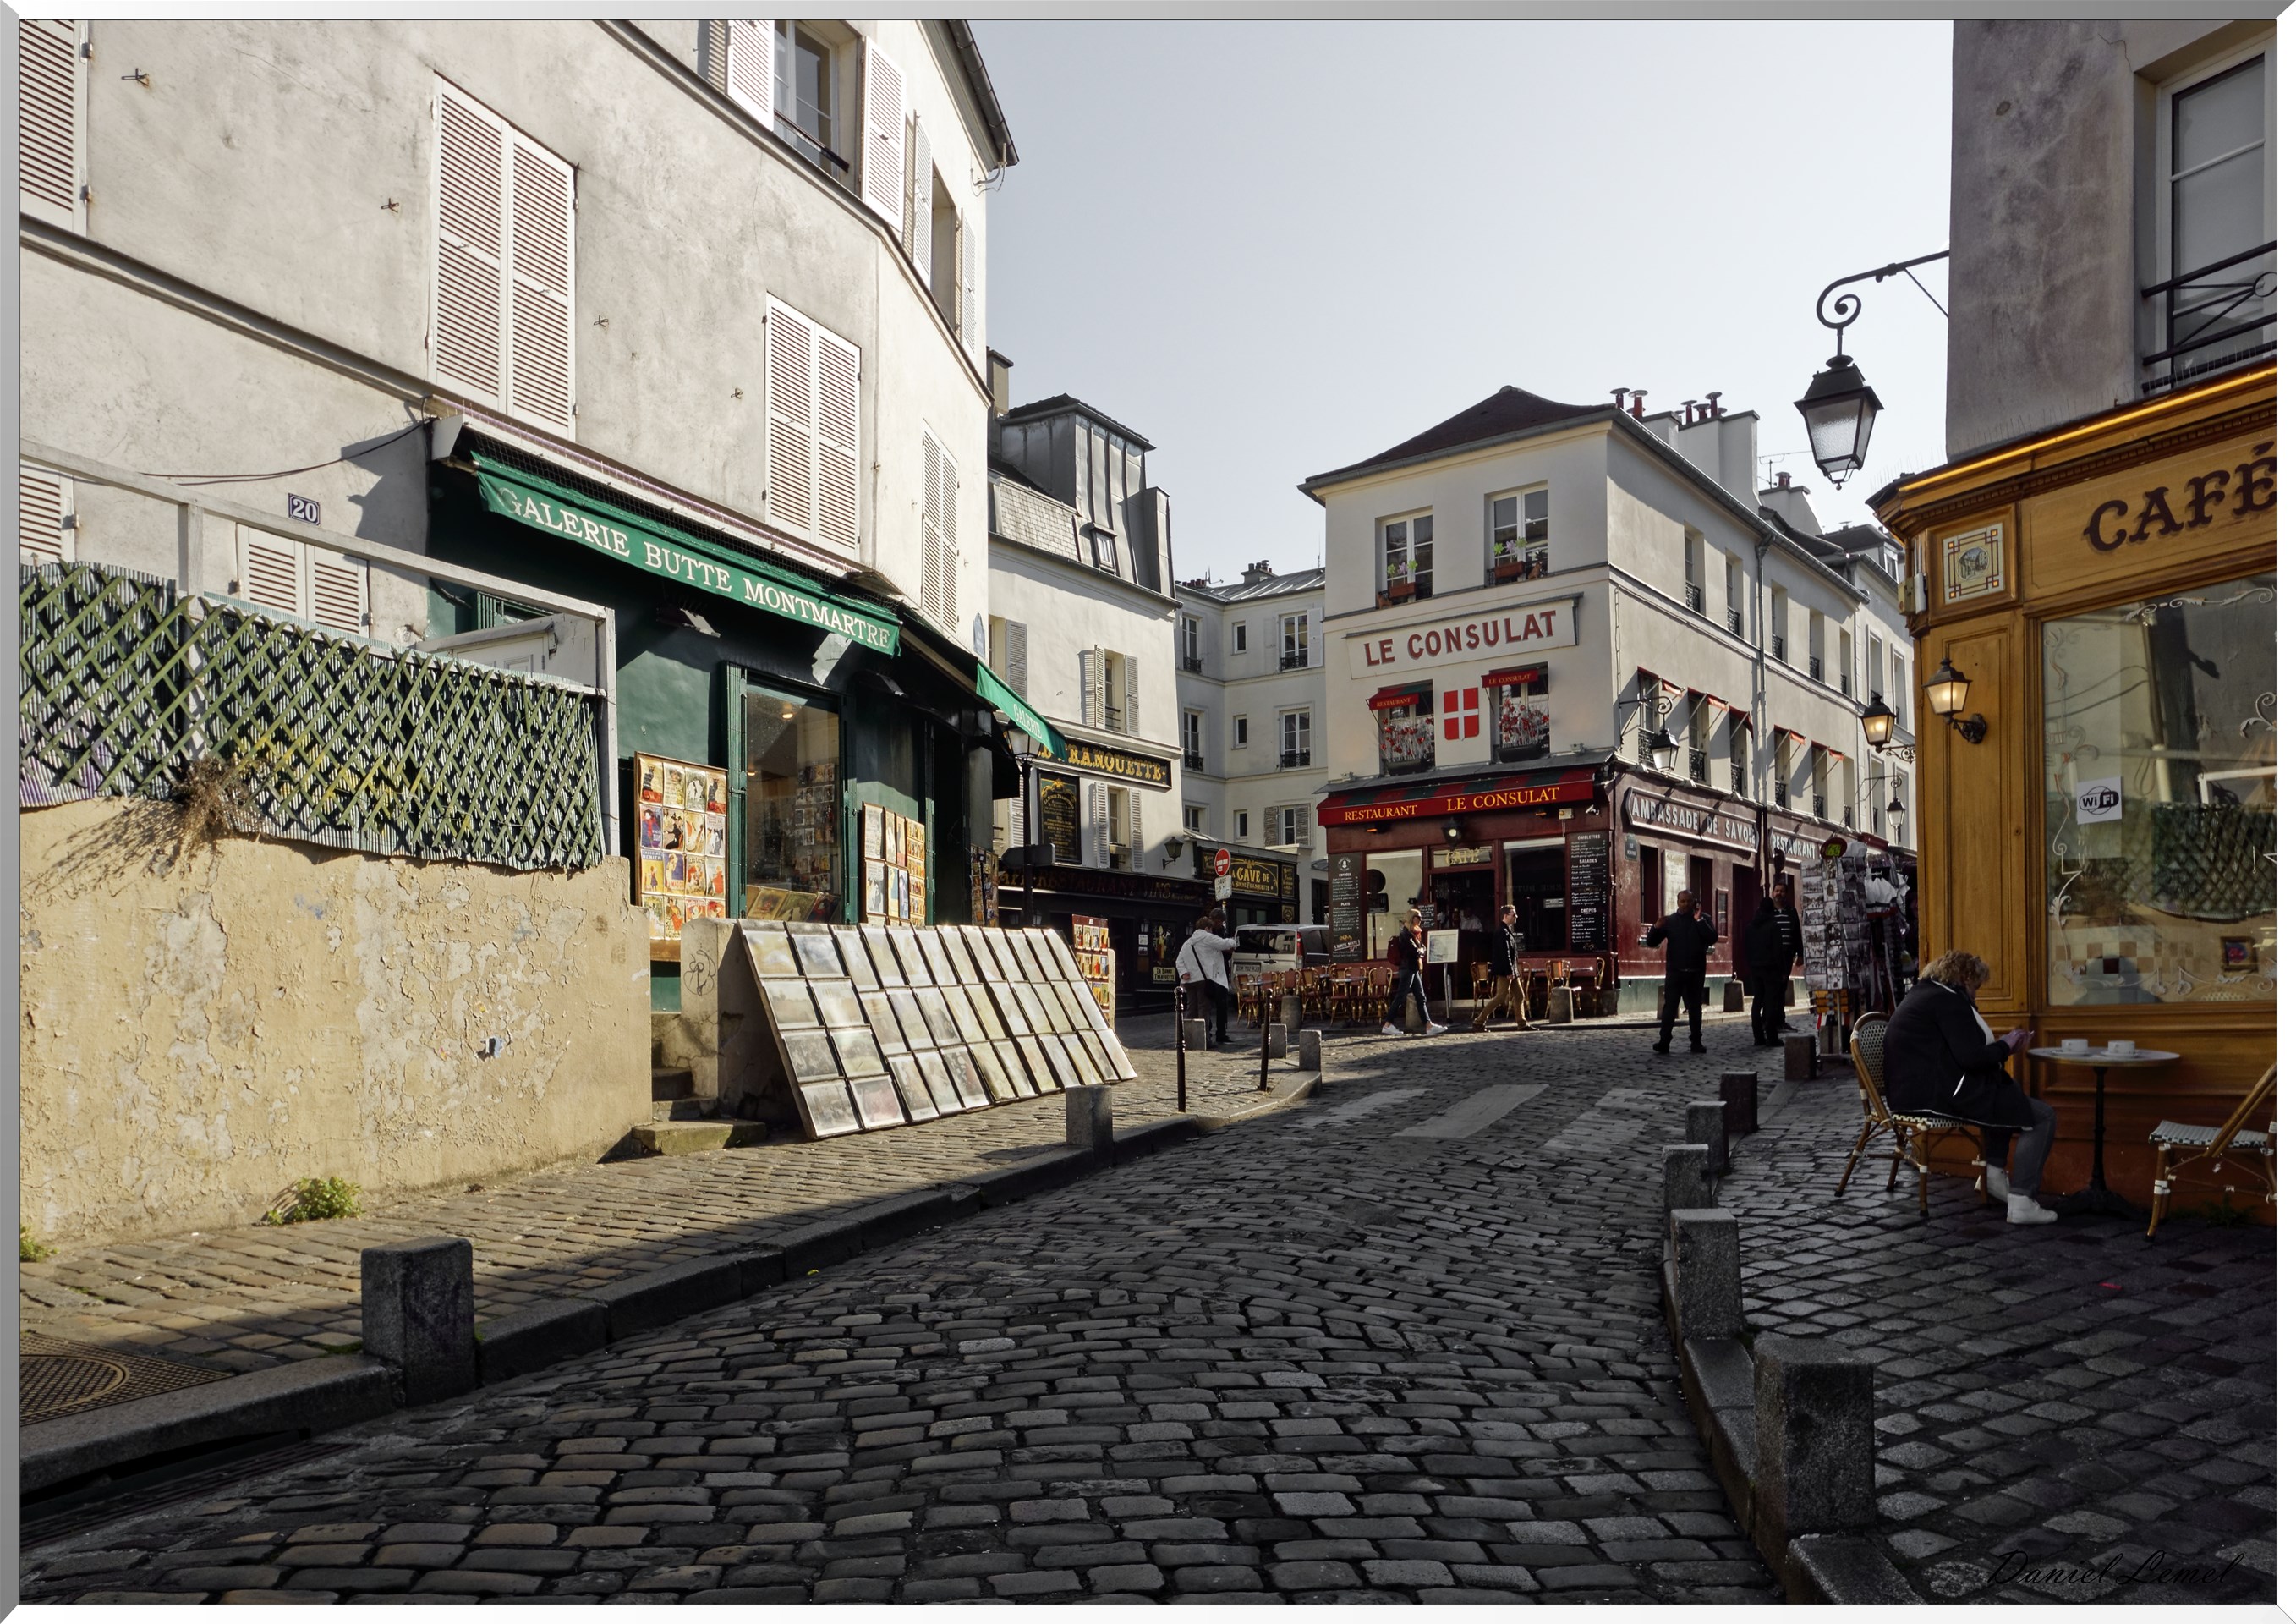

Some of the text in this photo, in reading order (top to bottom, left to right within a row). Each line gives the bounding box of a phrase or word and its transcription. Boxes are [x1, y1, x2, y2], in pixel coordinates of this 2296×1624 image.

[293, 498, 317, 522] 20
[2083, 441, 2277, 552] CAFÉ
[496, 486, 891, 649] GALERIE BUTTE MONTMARTRE
[1363, 610, 1557, 667] LE CONSULAT
[1499, 673, 1531, 684] CONSULAT
[1376, 697, 1411, 707] RESTAURANT
[1014, 704, 1042, 739] GALERIE
[1066, 744, 1162, 781] RANQUETTE
[1345, 787, 1560, 821] RESTAURANT LE CONSULAT
[1631, 797, 1756, 845] AMBASSADE DE SAVOIE
[1444, 847, 1480, 865] CAFÉ
[1772, 834, 1816, 859] RESTAURANT
[1236, 867, 1261, 883] CAVE
[1263, 873, 1270, 882] DE
